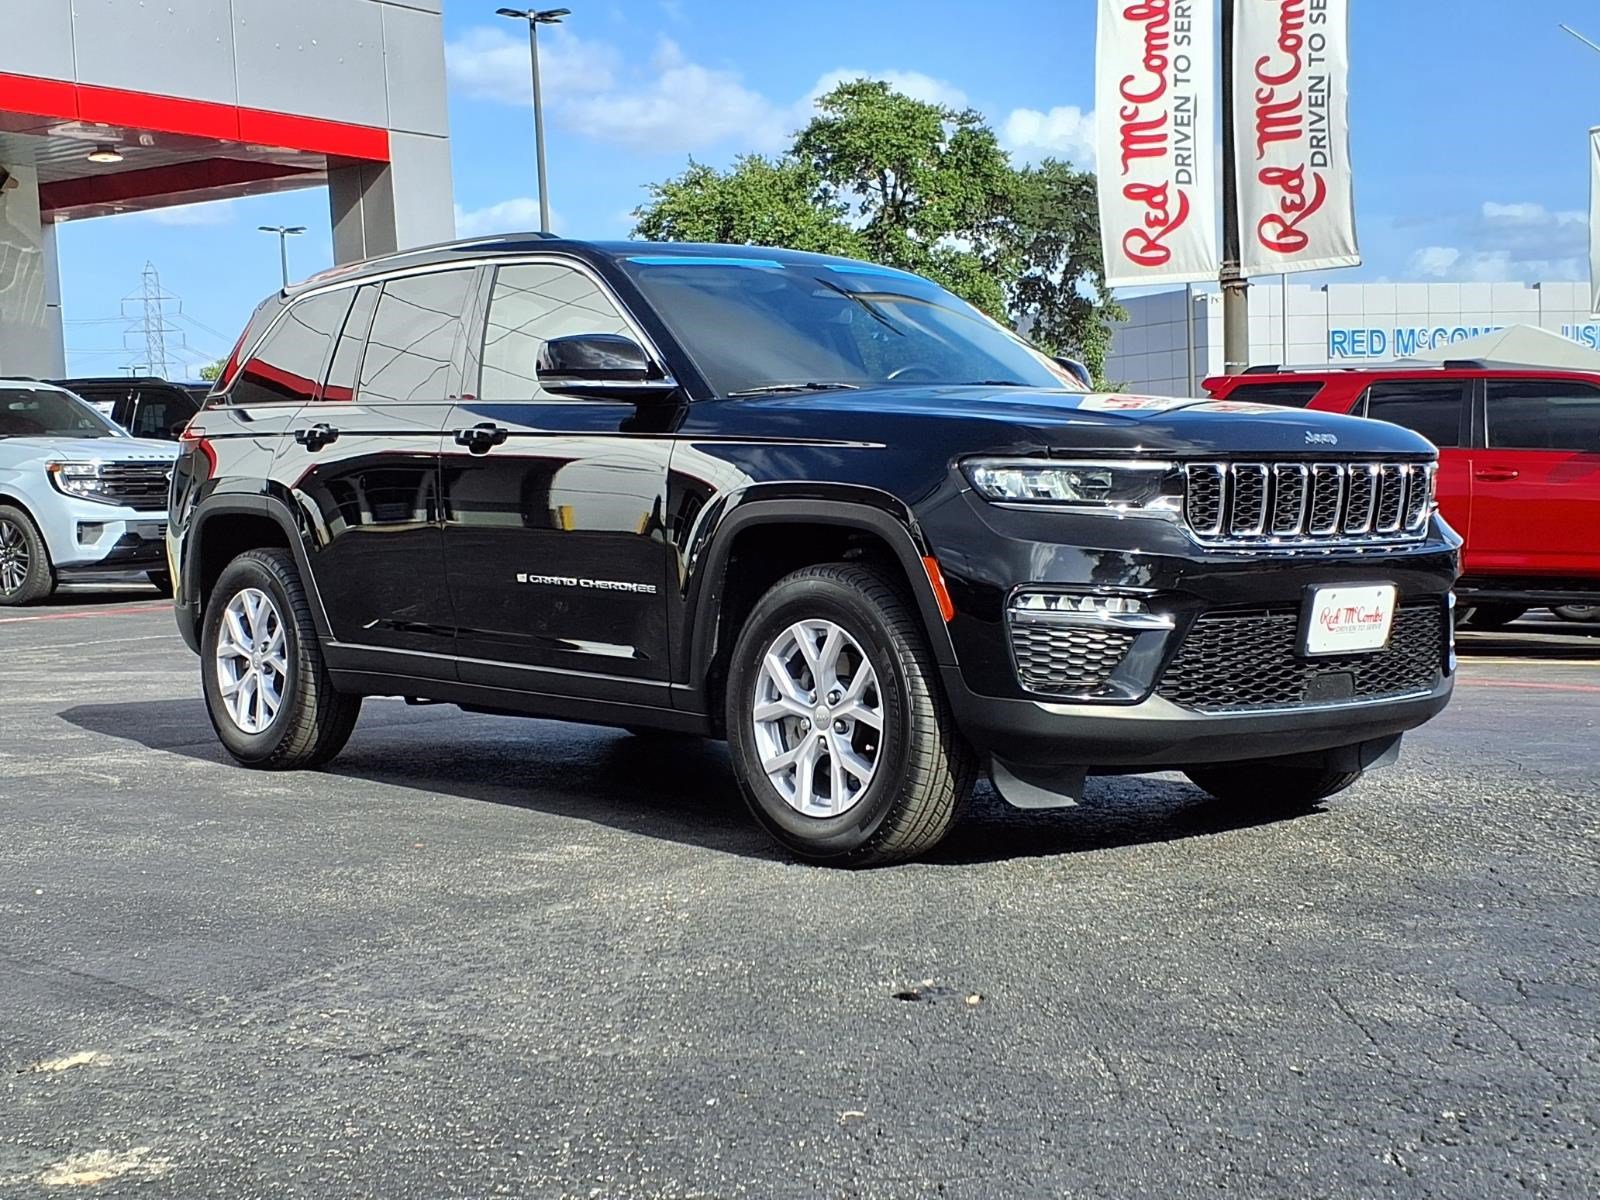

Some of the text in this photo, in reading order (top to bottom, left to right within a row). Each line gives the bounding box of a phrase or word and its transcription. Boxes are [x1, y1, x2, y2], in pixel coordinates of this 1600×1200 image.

[1173, 54, 1191, 87] TO
[1307, 0, 1328, 168] DRIVEN TO SE
[1119, 0, 1190, 267] Red McComb
[1173, 95, 1192, 185] DRIVEN
[1254, 0, 1327, 253] Red McCom
[1330, 329, 1387, 356] RED
[1304, 430, 1338, 446] Jeep
[529, 574, 657, 594] GRAND CHEROKEE
[1320, 605, 1384, 631] Red McCombs
